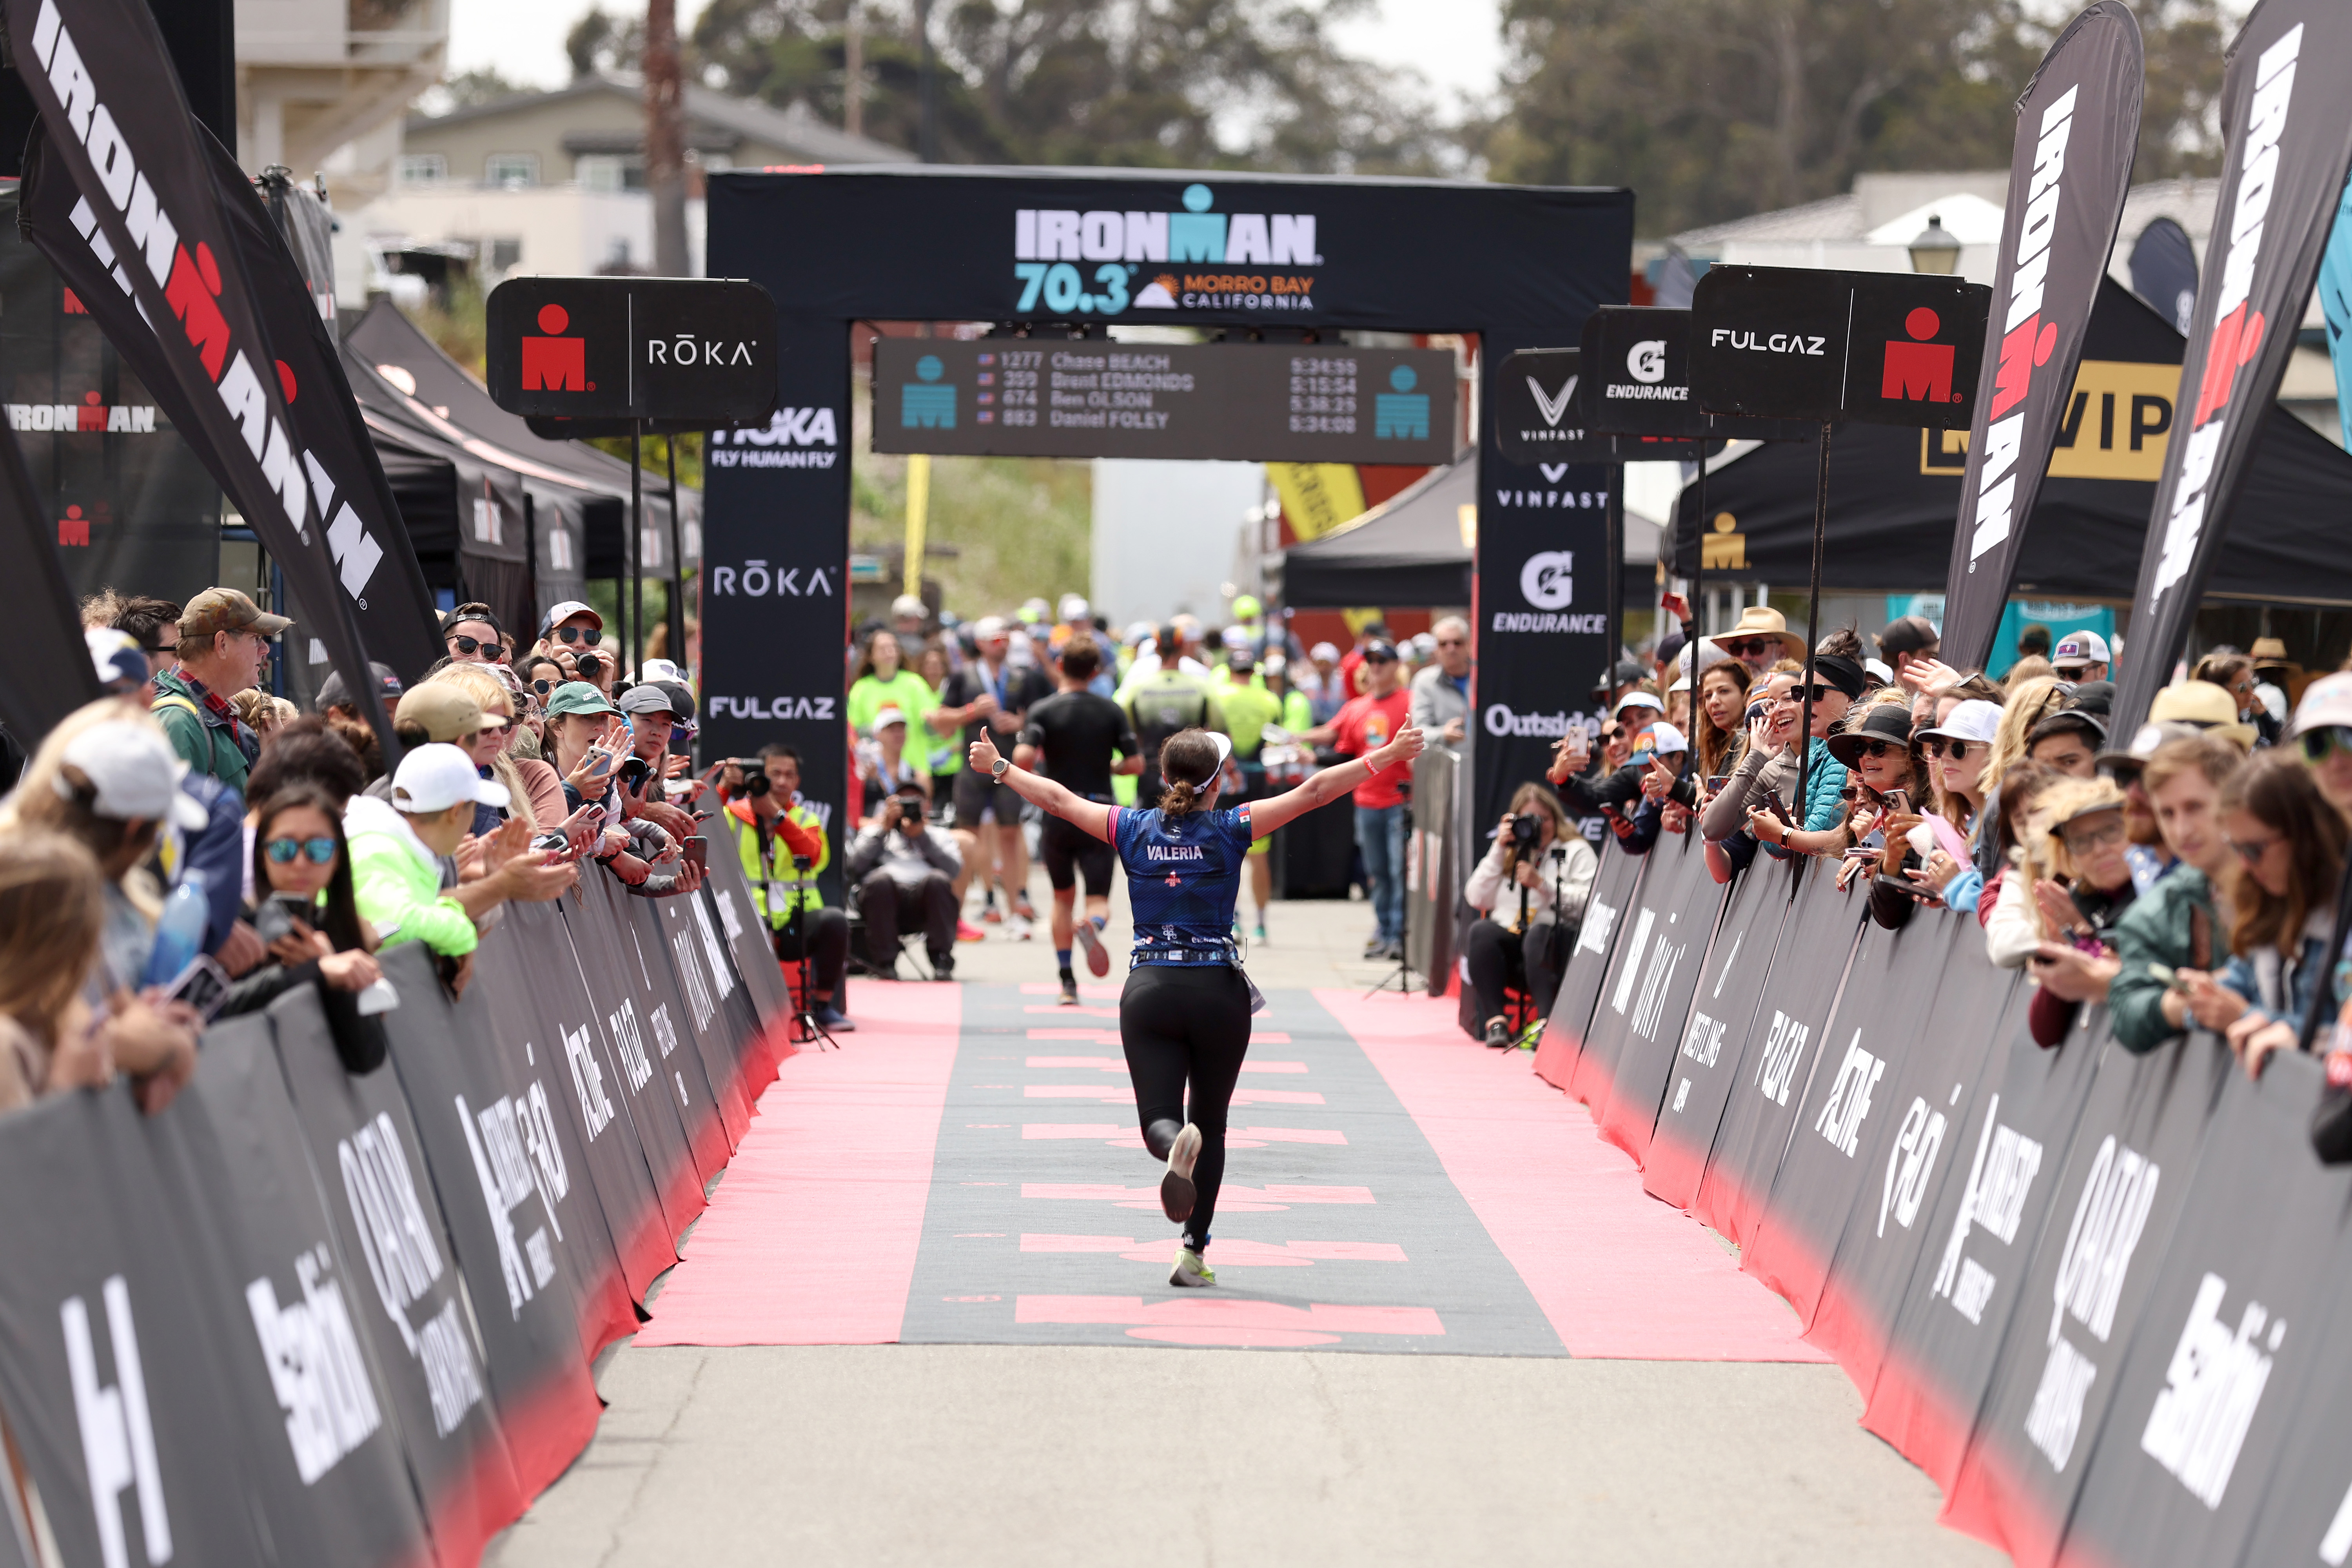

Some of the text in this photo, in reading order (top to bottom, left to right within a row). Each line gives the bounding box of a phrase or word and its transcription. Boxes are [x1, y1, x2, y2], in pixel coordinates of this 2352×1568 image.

[1015, 263, 1130, 314] 70.3
[1184, 274, 1314, 295] MORRO BAY
[1182, 293, 1313, 310] CALIFORNIA
[1711, 328, 1826, 356] FULGAZ
[1606, 384, 1689, 401] ENDURANCE
[711, 450, 837, 468] FLY HUMAN FLY
[1497, 490, 1608, 508] VINFAST
[1493, 612, 1606, 633] ENDURANCE
[710, 697, 835, 720] FULGAZ
[1147, 845, 1203, 861] VALERIA
[1683, 1011, 1727, 1069] BREITLING
[1754, 1009, 1809, 1107] FULGAZ
[1672, 1077, 1692, 1114] 1884
[1814, 1027, 1886, 1159] ACTIVE
